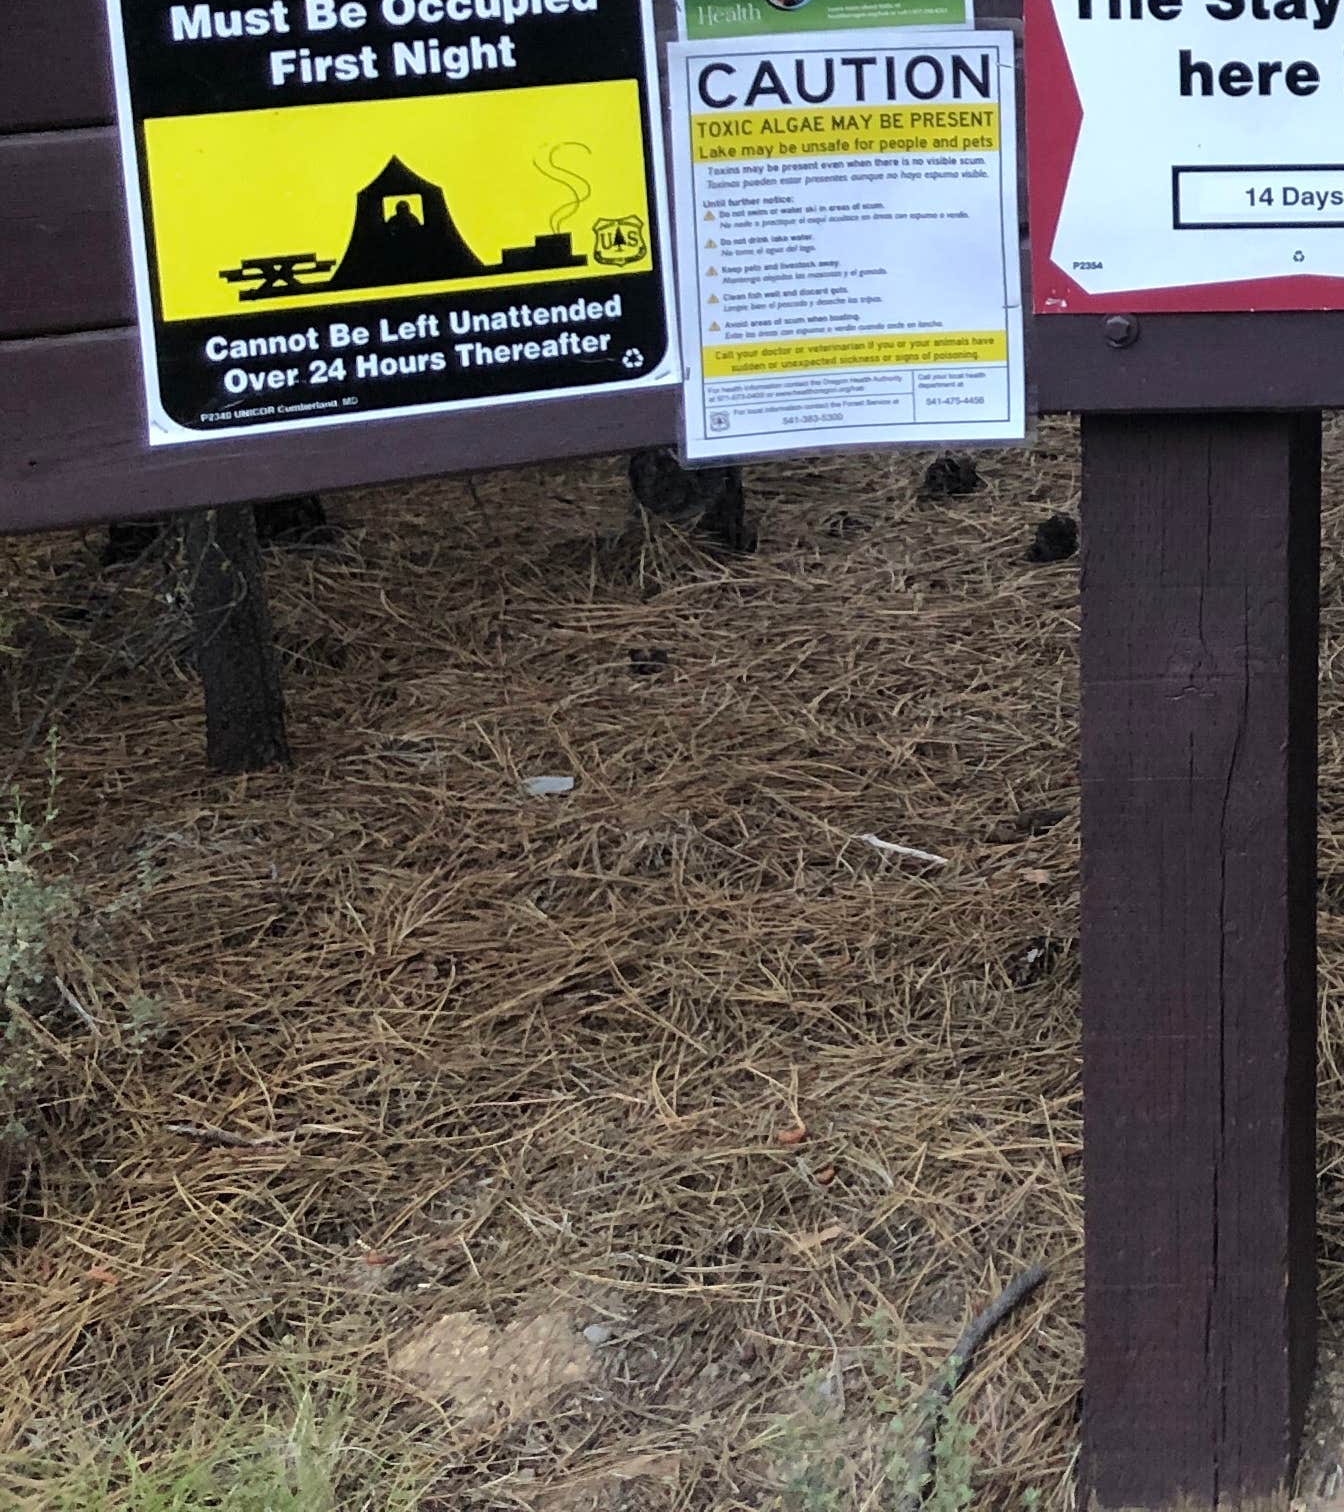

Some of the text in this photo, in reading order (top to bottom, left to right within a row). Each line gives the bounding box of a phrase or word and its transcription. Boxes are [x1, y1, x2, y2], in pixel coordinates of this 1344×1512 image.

[170, 0, 291, 42] Must
[694, 2, 765, 29] Health
[269, 35, 517, 86] First Night
[698, 53, 991, 109] CAUTION
[1179, 49, 1320, 97] here
[696, 110, 994, 139] TOXIC ALGAE MAY BE PRESENT
[699, 135, 994, 160] Lake may be unsafe for people and pets
[1245, 186, 1344, 211] 14 Days
[205, 293, 622, 362] Cannot Be Left Unattended
